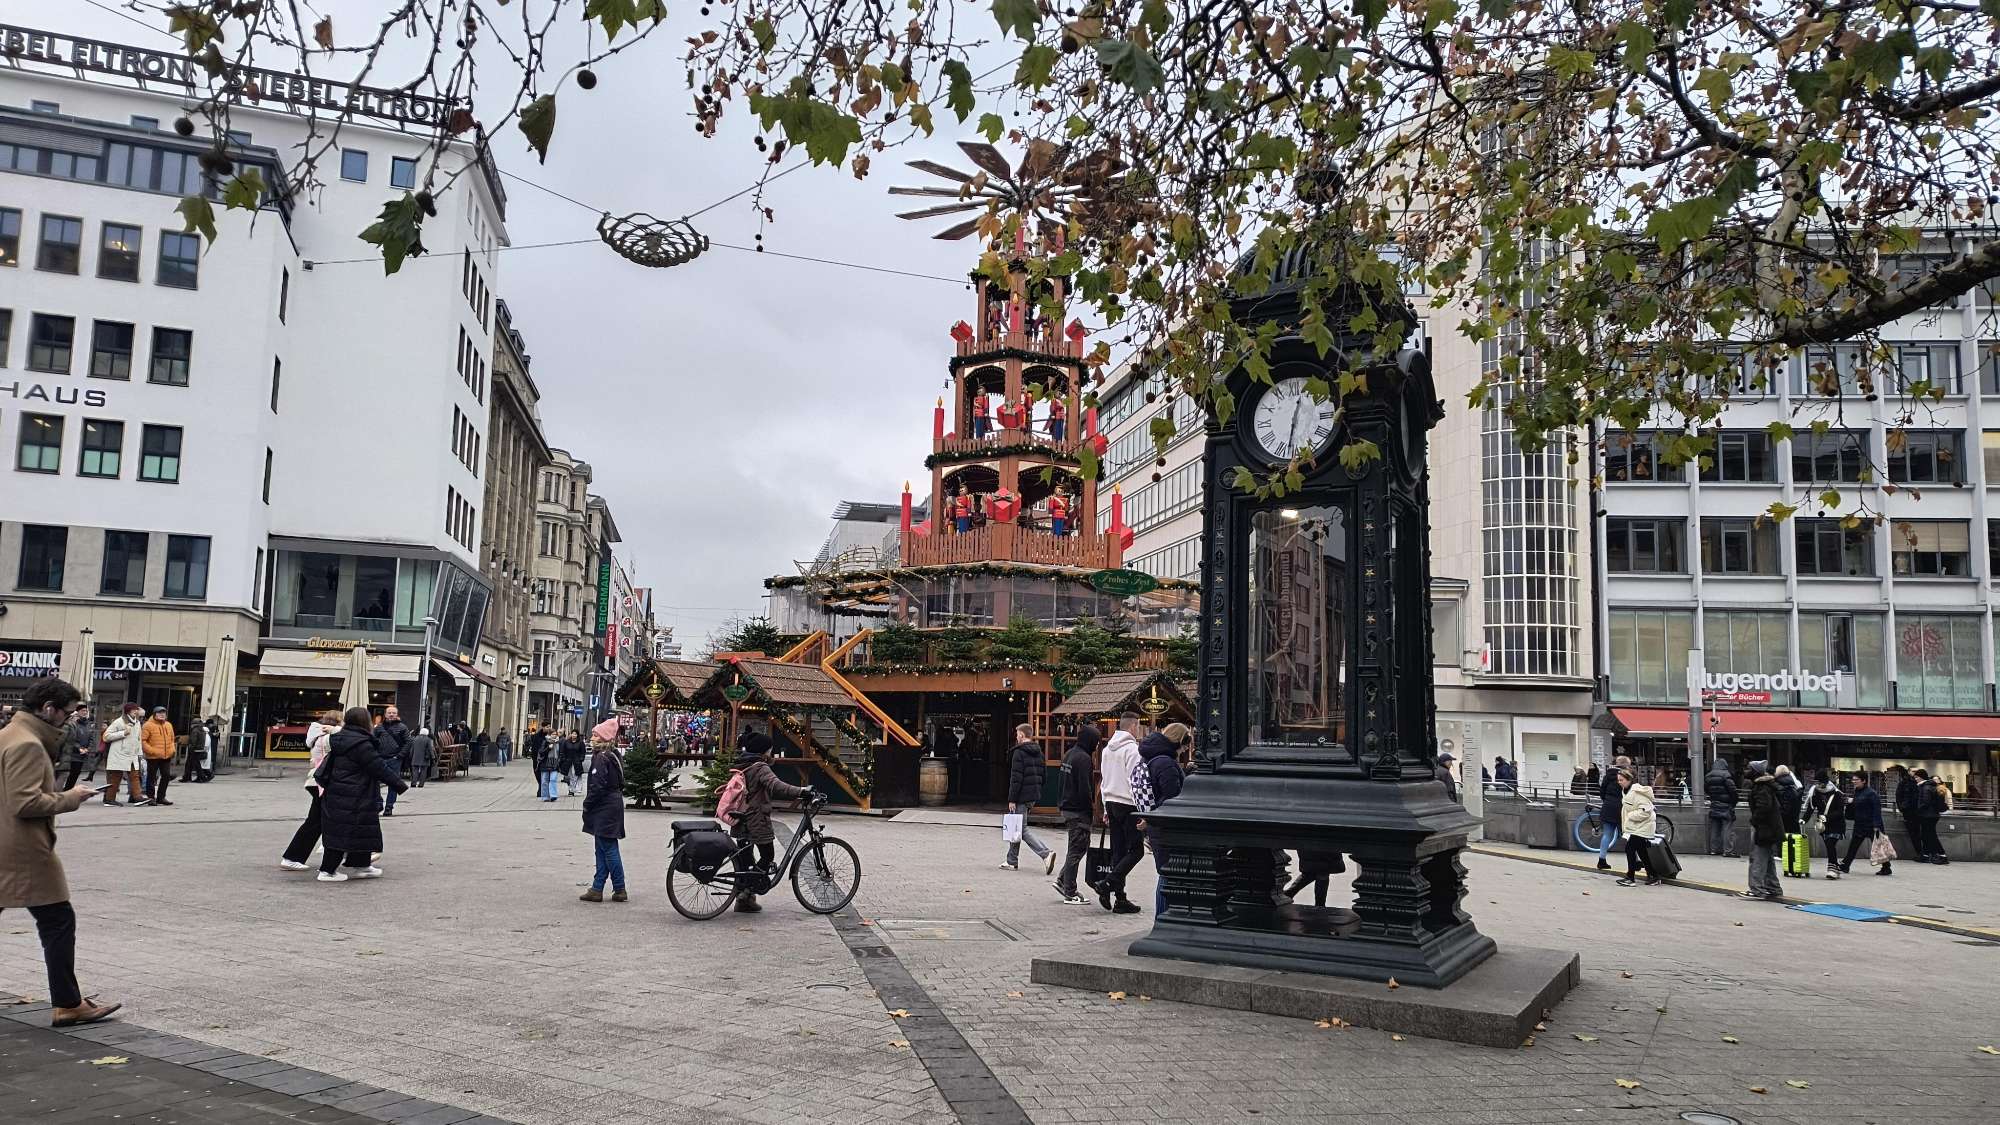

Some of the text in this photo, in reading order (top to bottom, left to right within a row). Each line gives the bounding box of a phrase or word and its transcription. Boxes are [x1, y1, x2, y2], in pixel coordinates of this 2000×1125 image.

[0, 29, 192, 82] BEL ELTRON
[599, 563, 610, 631] DEICHMANN
[11, 651, 57, 668] KLINIK
[115, 653, 178, 672] DÖNER
[1738, 693, 1765, 701] Bücher
